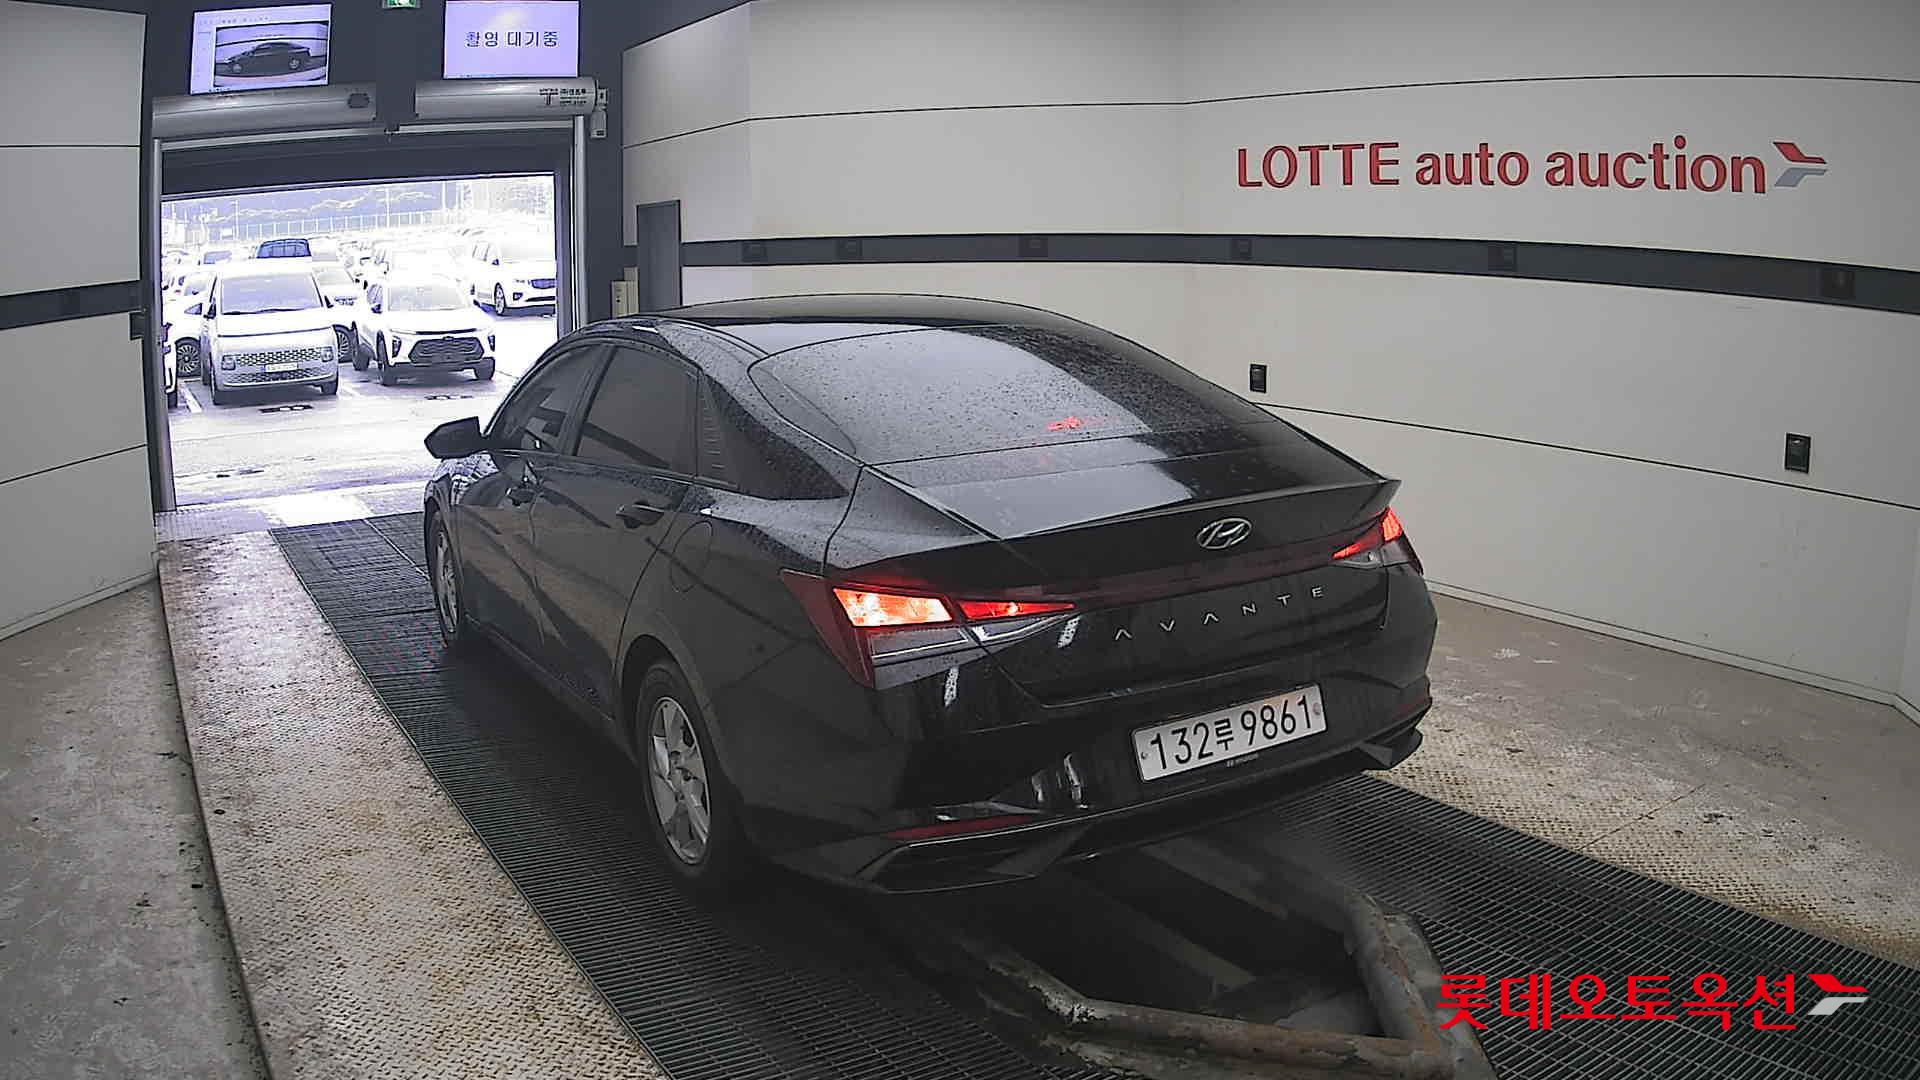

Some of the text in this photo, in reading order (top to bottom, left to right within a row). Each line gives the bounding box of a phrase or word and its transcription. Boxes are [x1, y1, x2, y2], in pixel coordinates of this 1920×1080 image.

[507, 31, 559, 48] 대기중
[1237, 136, 1767, 193] LOTTE auto auction
[1115, 586, 1324, 641] AVANTE
